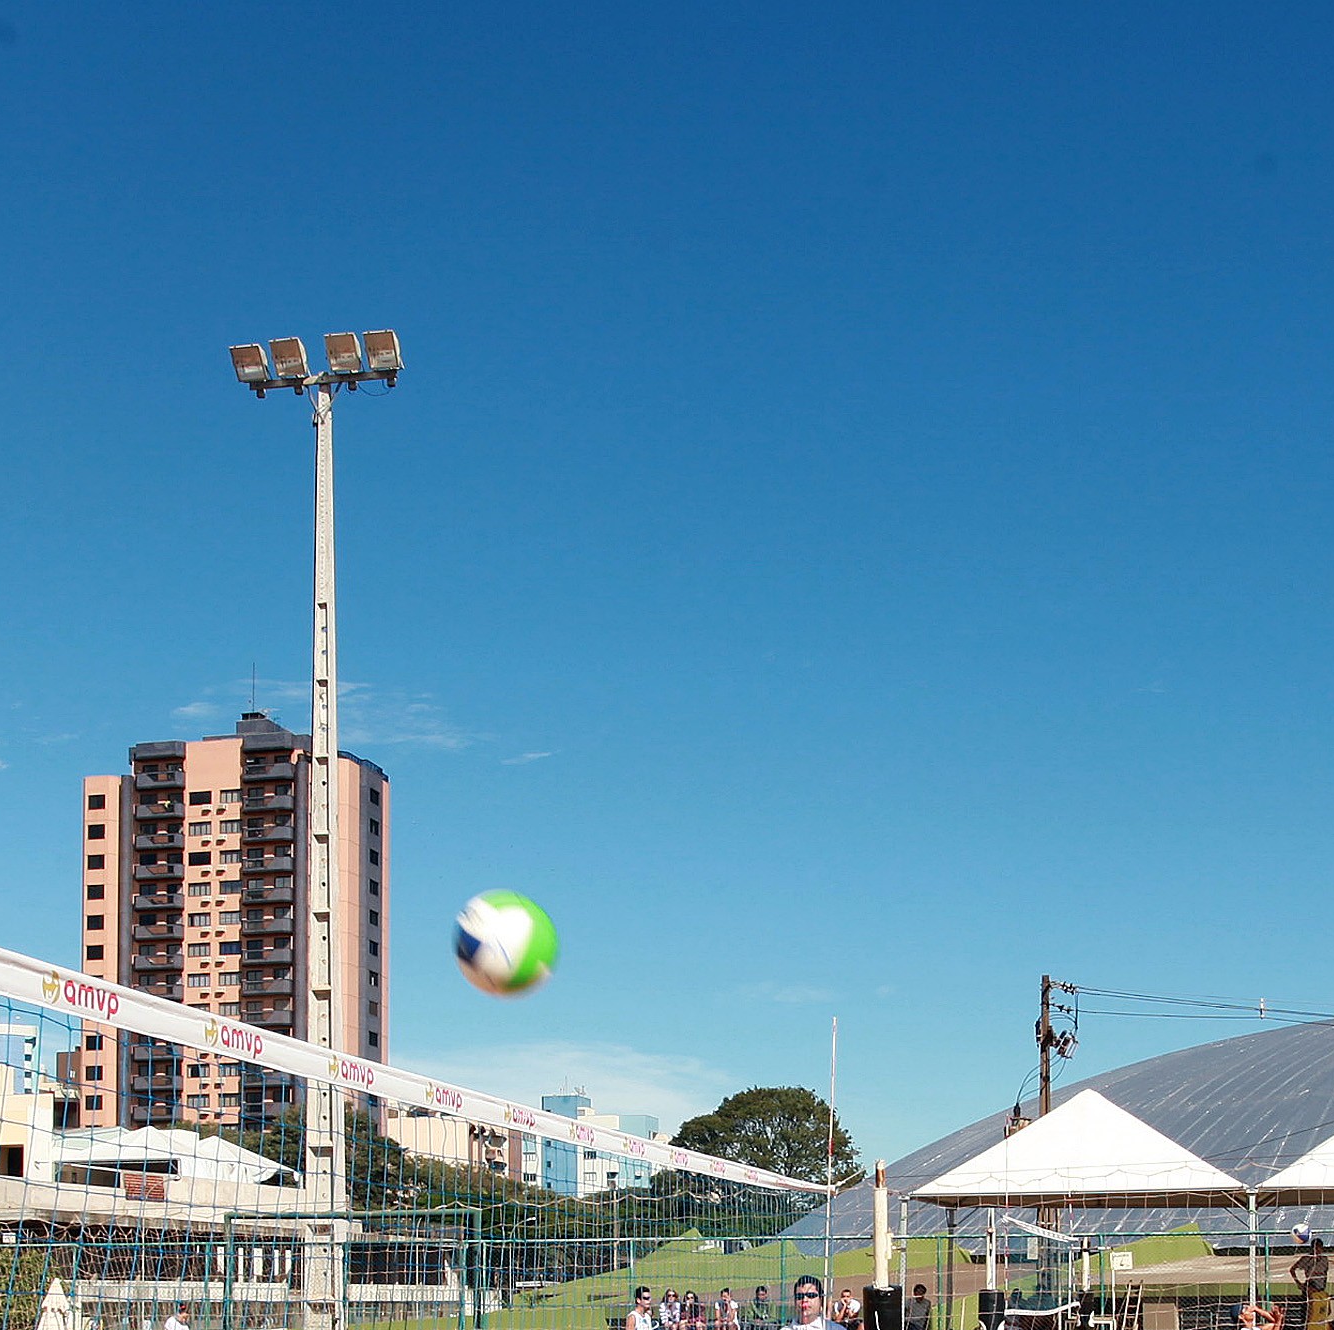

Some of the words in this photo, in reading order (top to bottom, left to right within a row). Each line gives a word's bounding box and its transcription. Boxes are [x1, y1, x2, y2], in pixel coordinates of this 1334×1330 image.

[64, 980, 119, 1020] amvp
[221, 1025, 263, 1059] amvp
[341, 1060, 375, 1089] amvp
[436, 1087, 462, 1112] amvp
